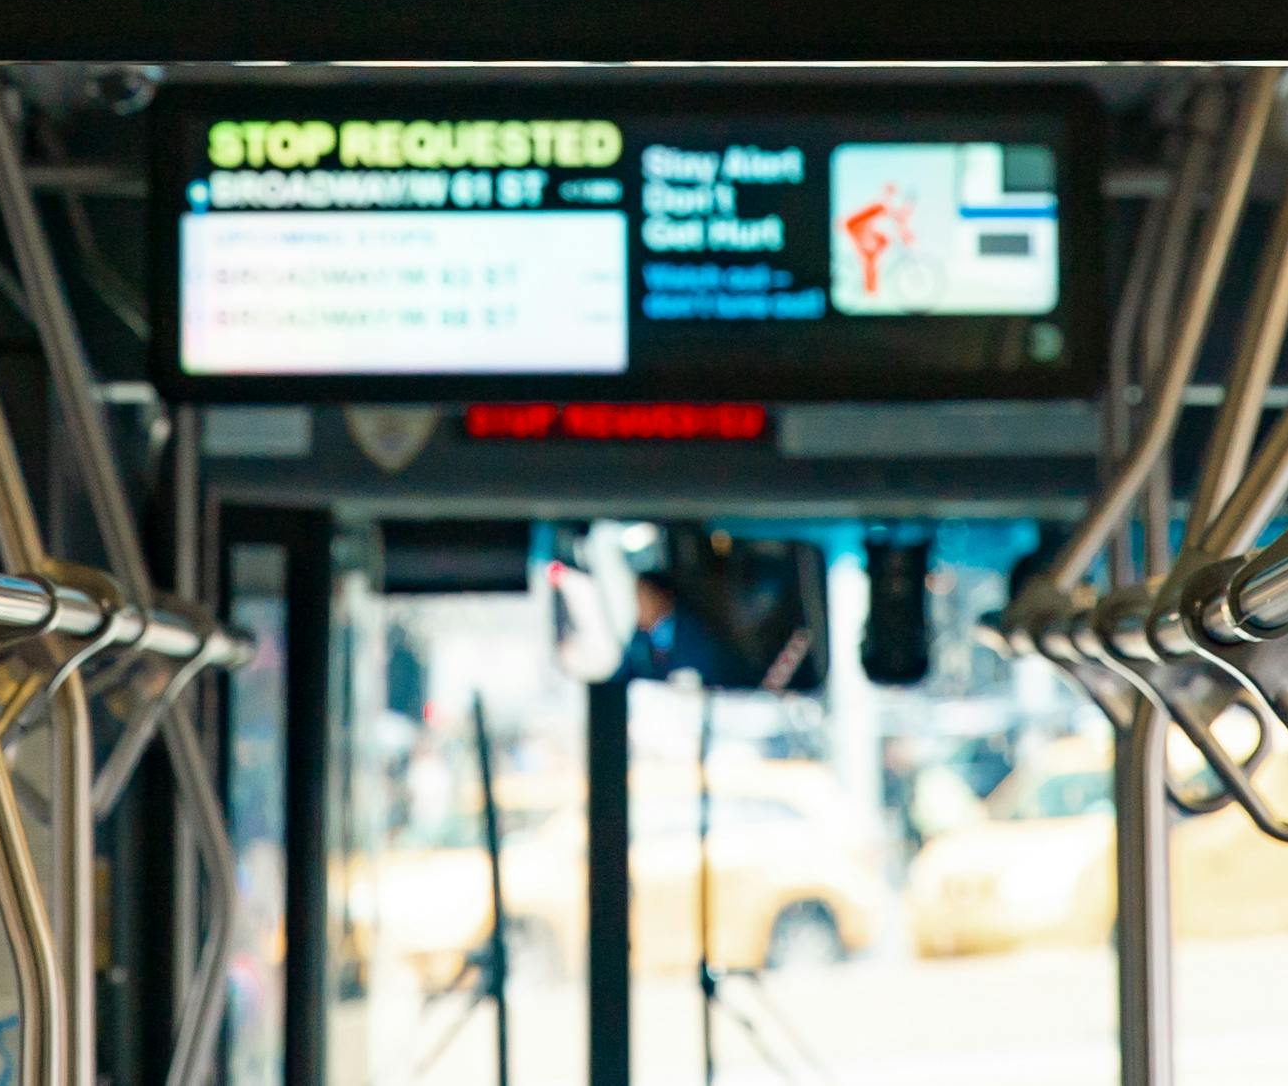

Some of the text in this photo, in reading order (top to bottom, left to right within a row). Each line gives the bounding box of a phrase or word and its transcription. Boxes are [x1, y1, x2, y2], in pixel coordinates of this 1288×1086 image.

[208, 119, 623, 169] STOP REQUESTED
[496, 171, 549, 208] ST
